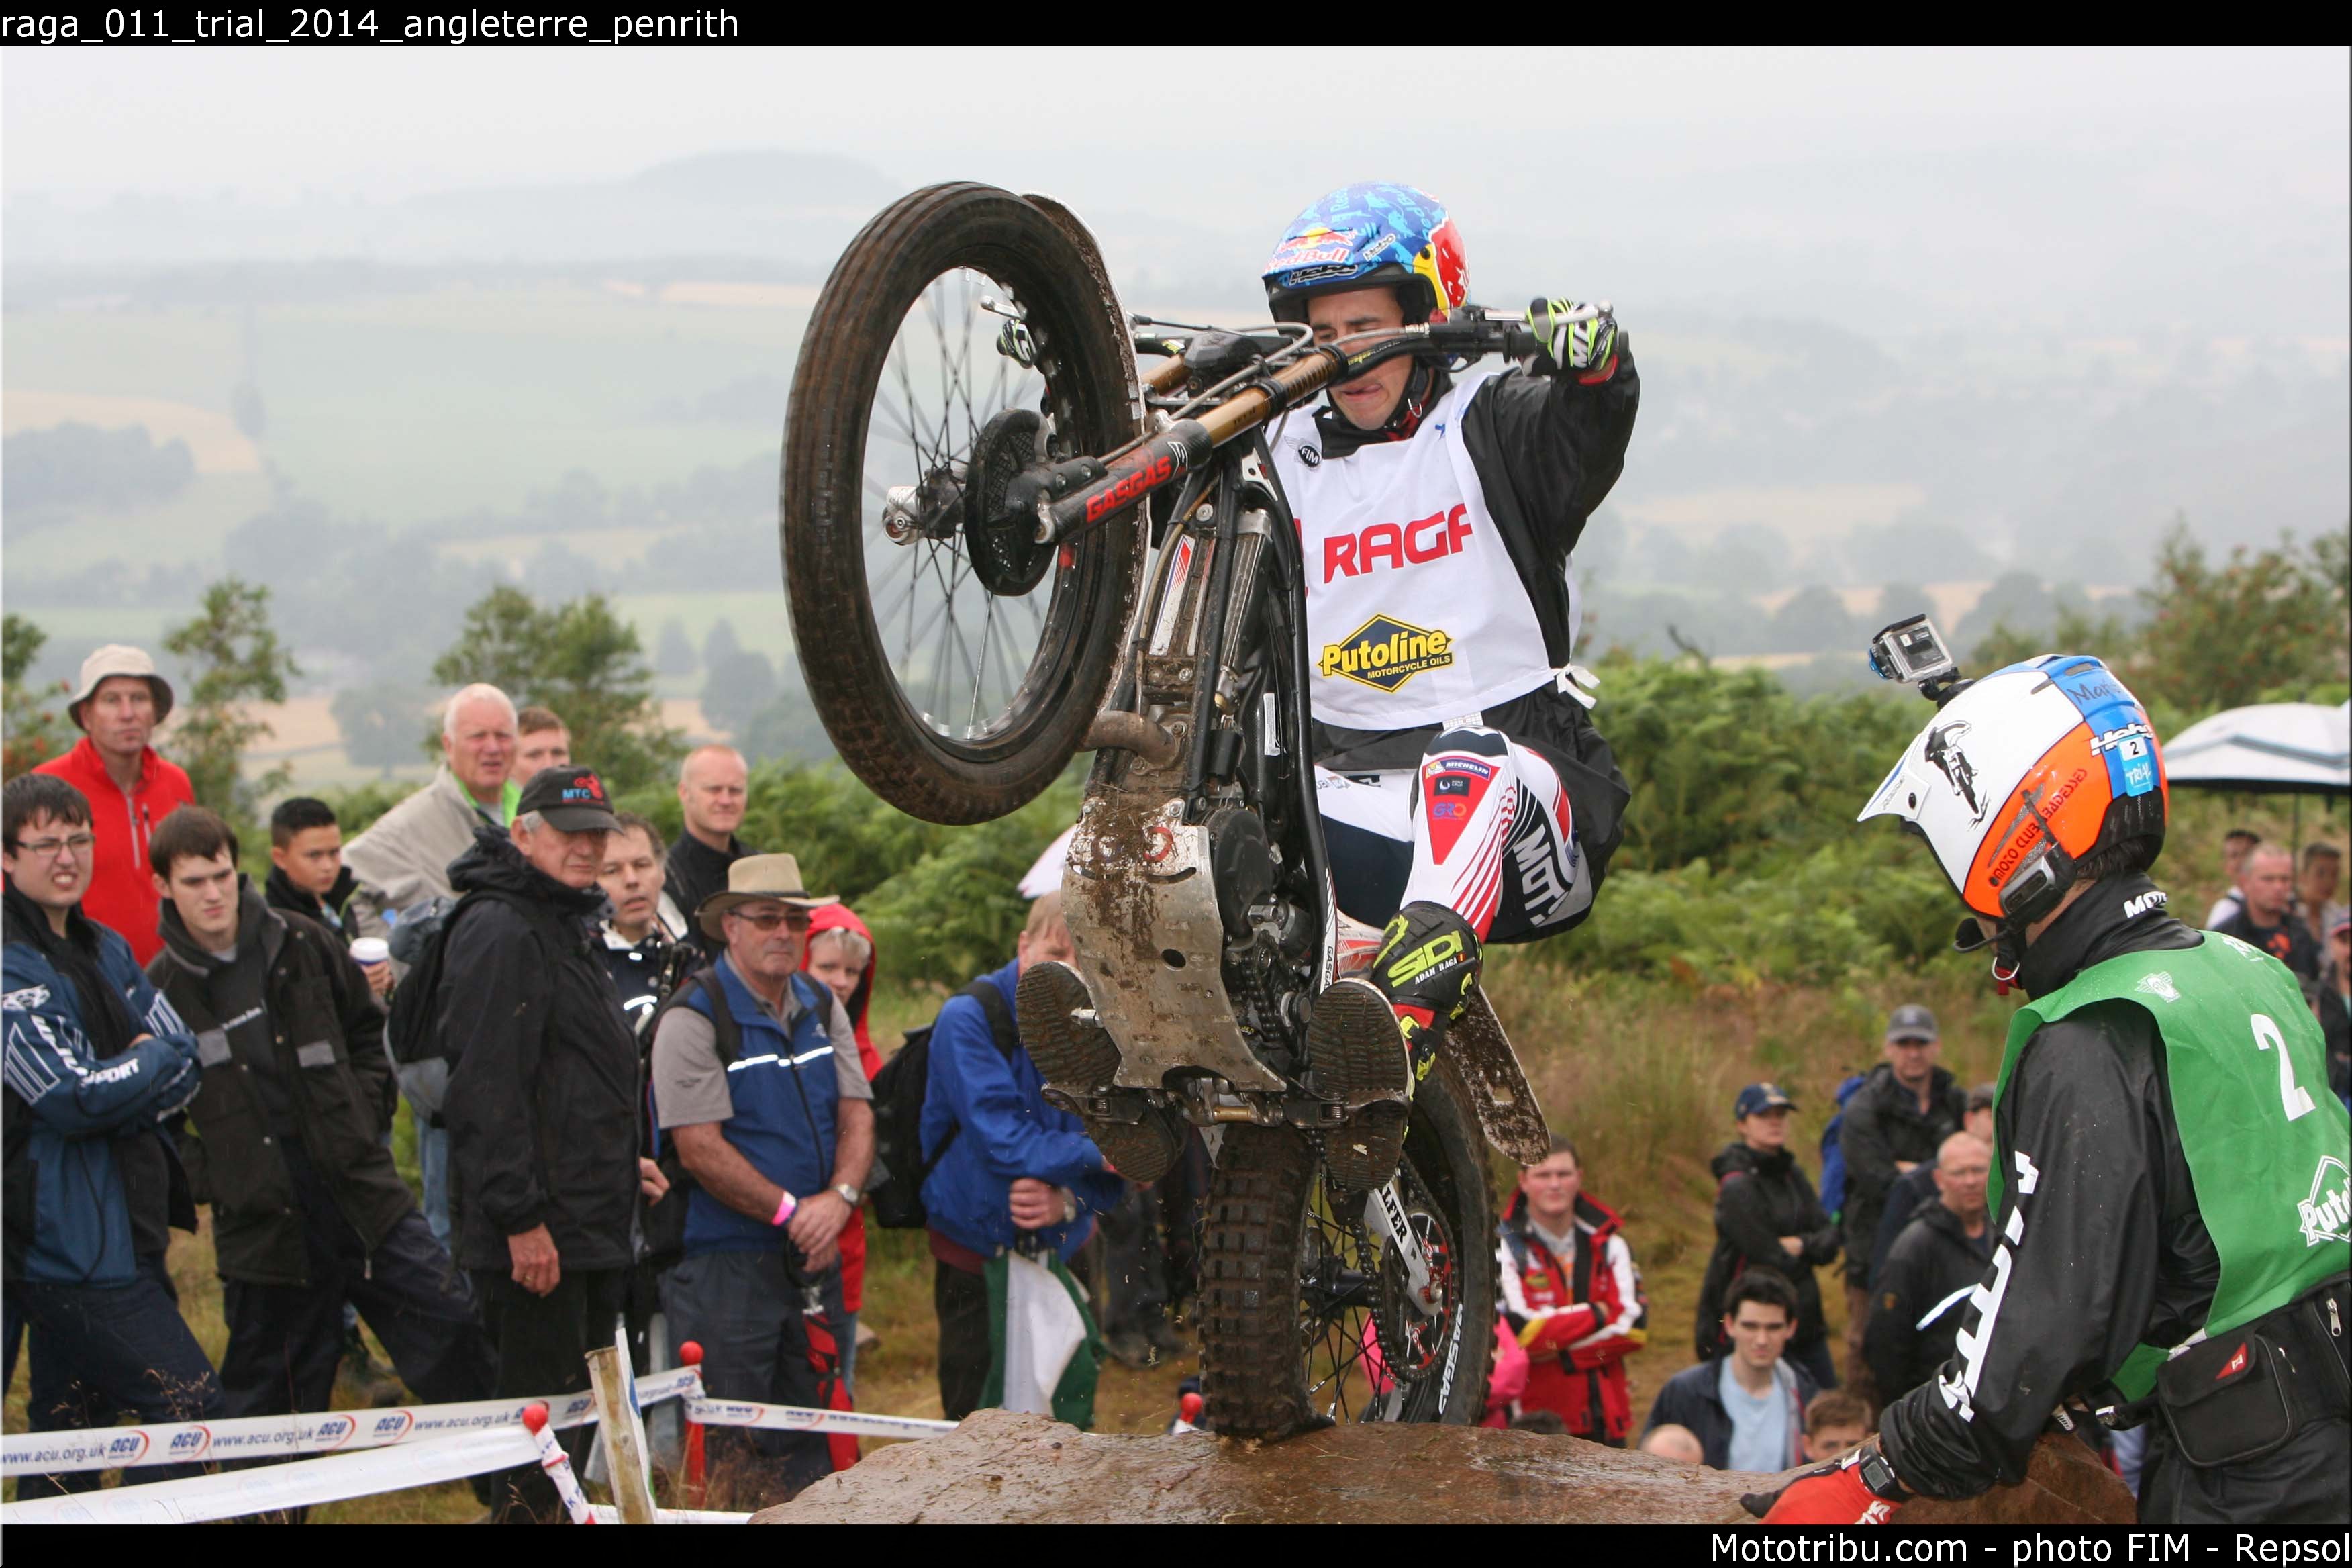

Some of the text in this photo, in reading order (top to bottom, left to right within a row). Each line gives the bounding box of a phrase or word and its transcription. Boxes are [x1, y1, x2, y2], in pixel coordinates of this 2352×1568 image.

[1301, 447, 1320, 464] FIM
[1086, 456, 1172, 523] GASGAS
[1323, 630, 1447, 676] Putoline
[1367, 655, 1450, 679] MOTORCYCLE OILS
[2130, 741, 2139, 756] 2
[1446, 762, 1489, 775] MICHELIN
[562, 789, 591, 800] MTC
[1324, 946, 1334, 987] GASGA
[1414, 957, 1457, 985] ADAM RAGA
[2250, 1014, 2316, 1121] 2
[1382, 1186, 1407, 1244] LFER
[109, 1436, 140, 1453] ACU
[169, 1431, 203, 1449] ACU
[213, 1427, 313, 1448] www.acu.org.uk
[317, 1420, 348, 1436] ACU
[374, 1416, 407, 1431] ACU
[414, 1412, 510, 1431] www.acu.org.uk
